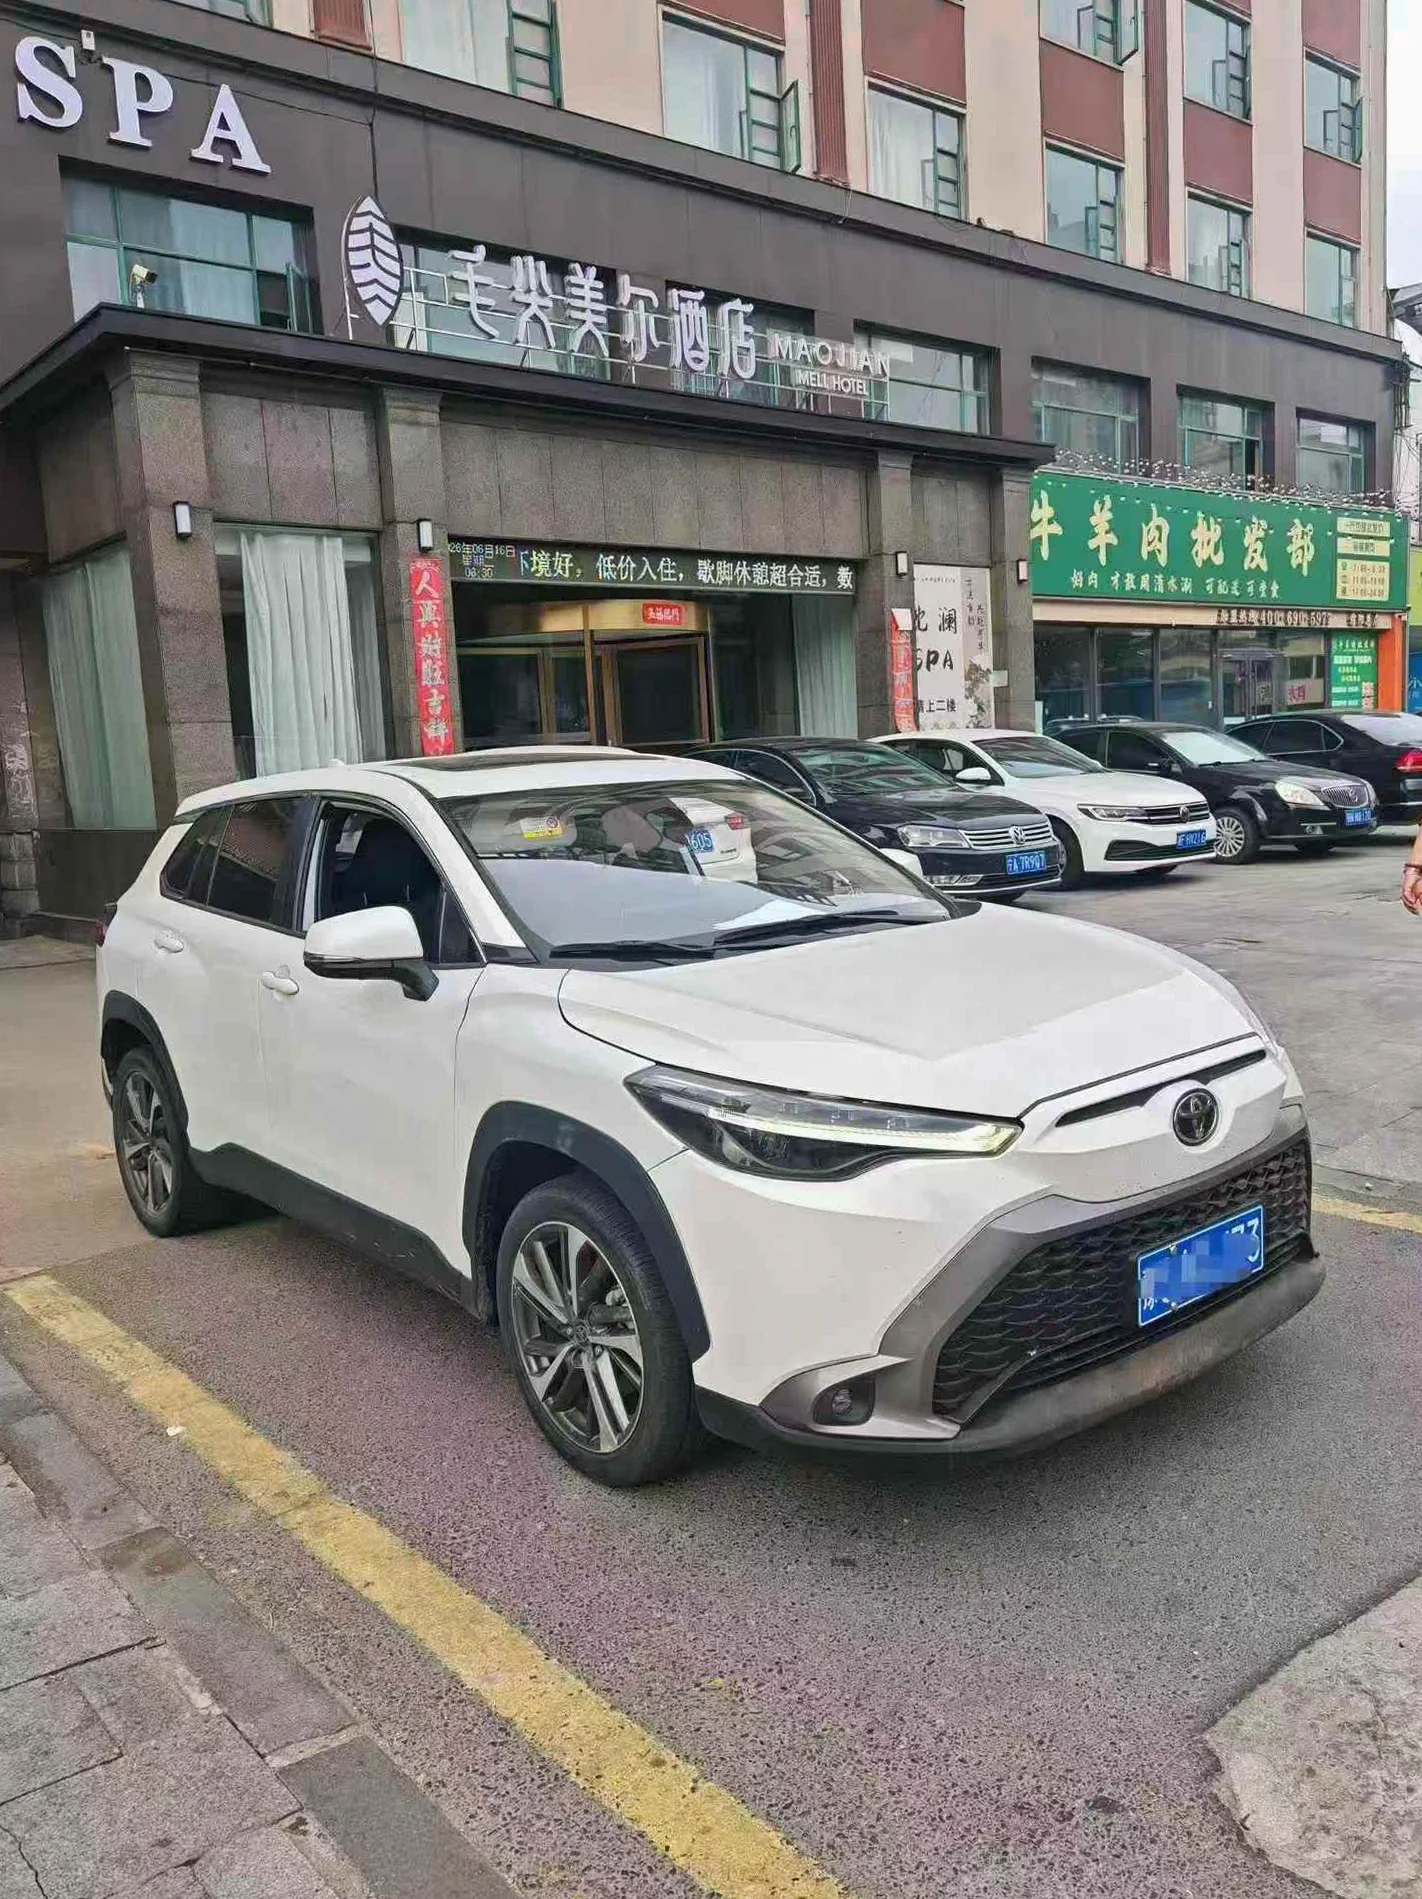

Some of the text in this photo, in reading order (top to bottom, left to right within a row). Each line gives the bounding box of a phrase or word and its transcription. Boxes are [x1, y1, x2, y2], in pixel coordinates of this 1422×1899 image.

[15, 37, 271, 174] SPA
[446, 245, 756, 380] 毛尖美尔酒店
[771, 333, 890, 379] MAOJIAN
[832, 375, 868, 396] HOTEL
[1030, 489, 1315, 577] 牛羊肉批发部
